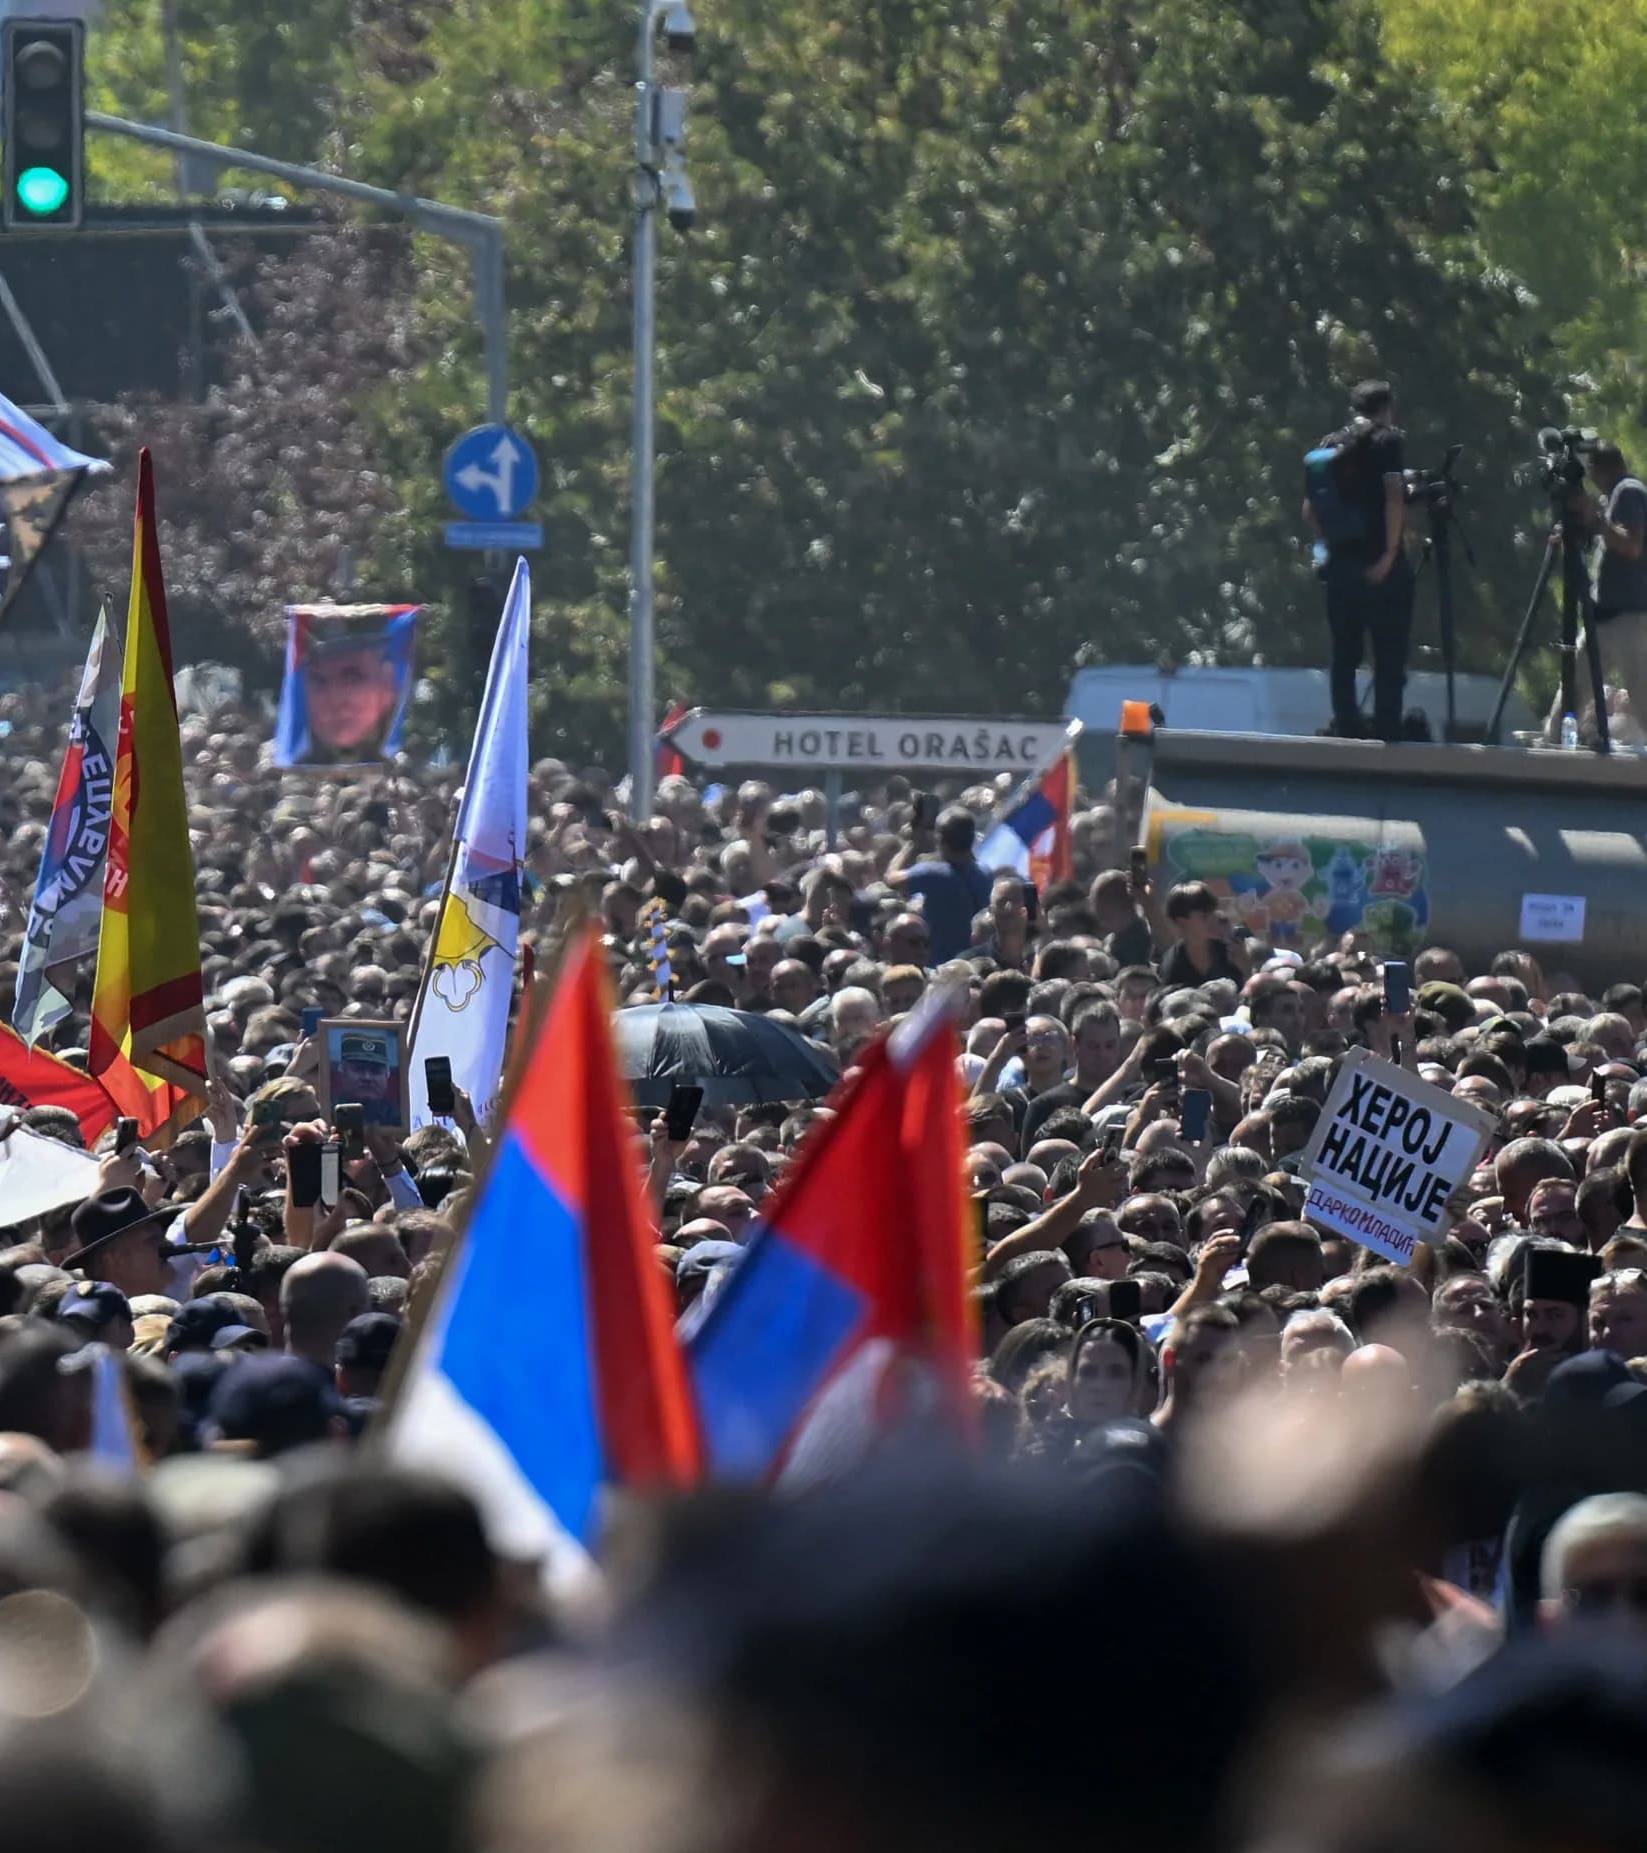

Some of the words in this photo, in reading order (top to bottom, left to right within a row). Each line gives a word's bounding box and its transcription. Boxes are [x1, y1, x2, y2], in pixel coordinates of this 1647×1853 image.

[773, 730, 883, 758] HOTEL
[899, 727, 1039, 761] ORAŠAC
[1337, 1073, 1453, 1165] ХЕРОЈ
[1316, 1123, 1452, 1223] НАЦИЈЕ
